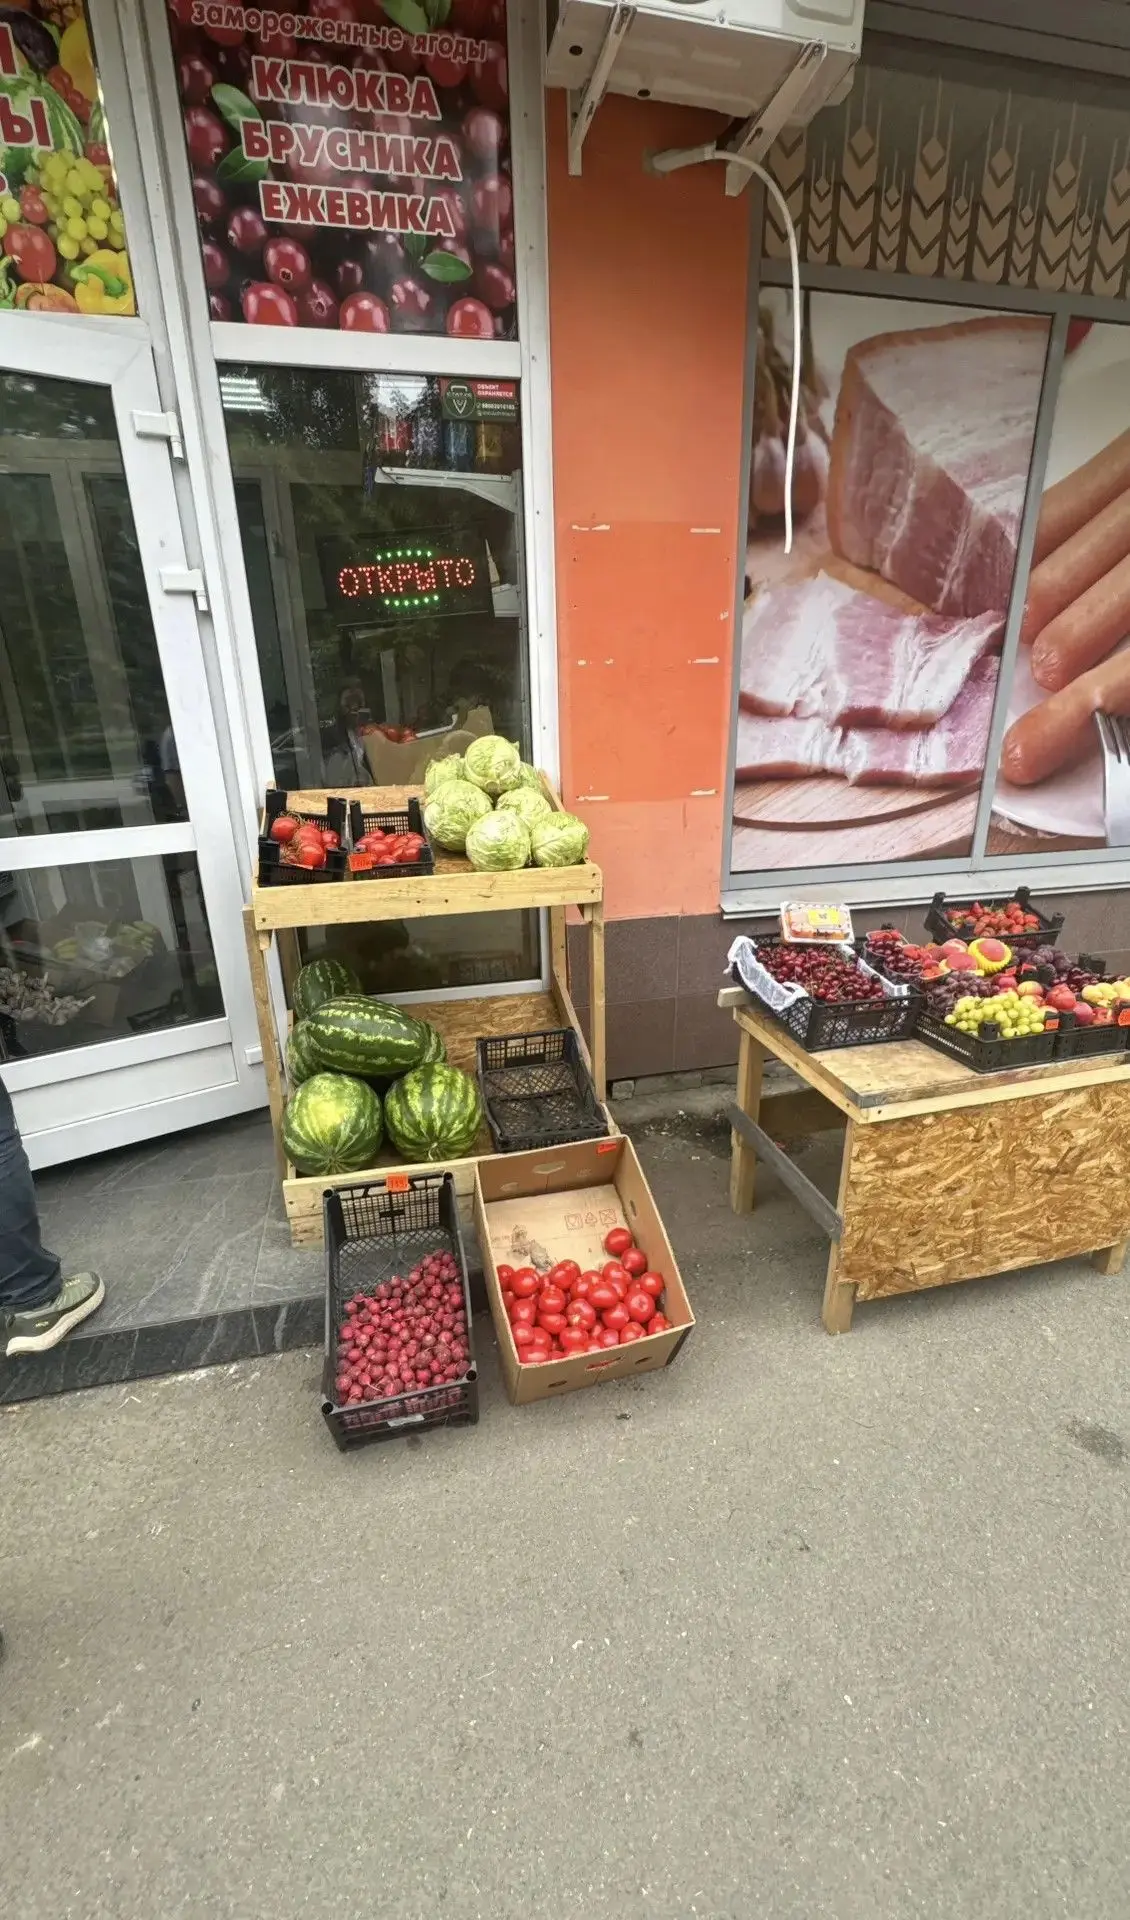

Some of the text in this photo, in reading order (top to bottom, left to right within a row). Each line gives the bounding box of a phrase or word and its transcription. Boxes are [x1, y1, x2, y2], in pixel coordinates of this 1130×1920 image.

[191, 2, 488, 62] замороженные ягоды
[251, 55, 442, 120] КЛЮКВА
[240, 118, 463, 181] БРУСНИКА
[258, 179, 456, 237] ЕЖЕВИКА
[338, 558, 475, 597] ОТКРЫТО
